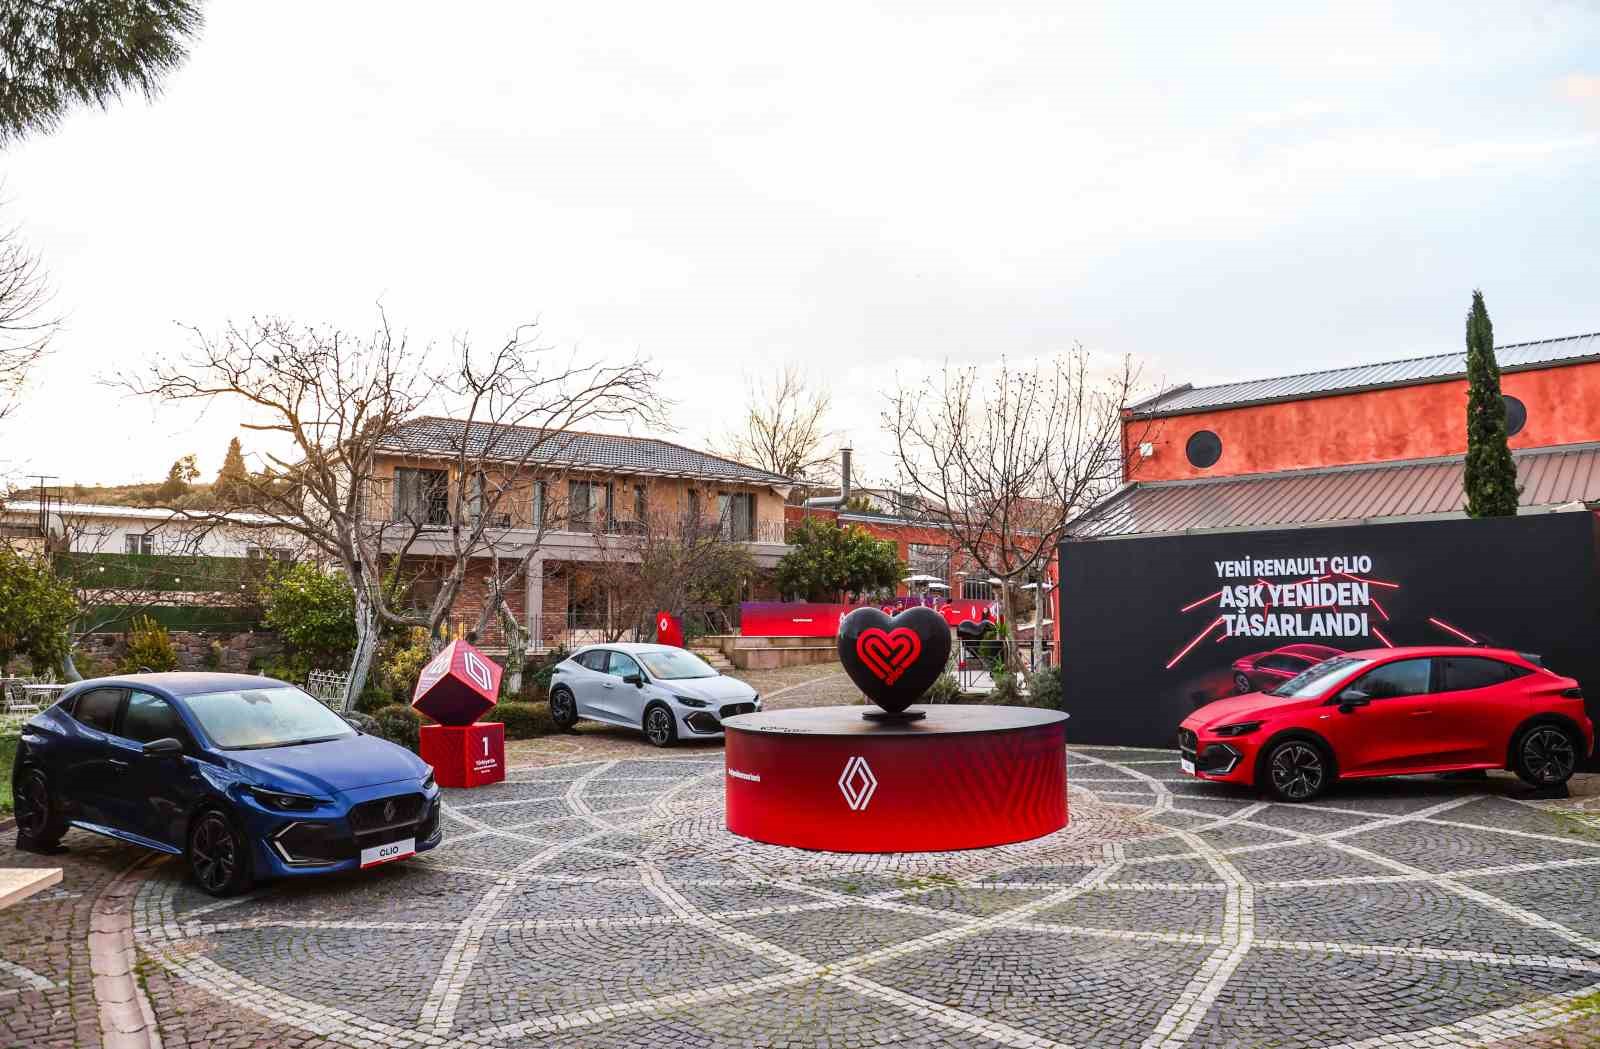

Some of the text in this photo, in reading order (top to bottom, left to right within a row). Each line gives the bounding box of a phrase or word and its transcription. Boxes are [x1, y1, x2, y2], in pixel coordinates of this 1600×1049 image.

[1214, 555, 1372, 577] YENİ RENAULT CLIO
[1219, 577, 1370, 613] AŞK YENİDEN
[1222, 612, 1369, 637] TASARLANDI
[482, 736, 489, 756] 1
[379, 846, 399, 857] CLIO
